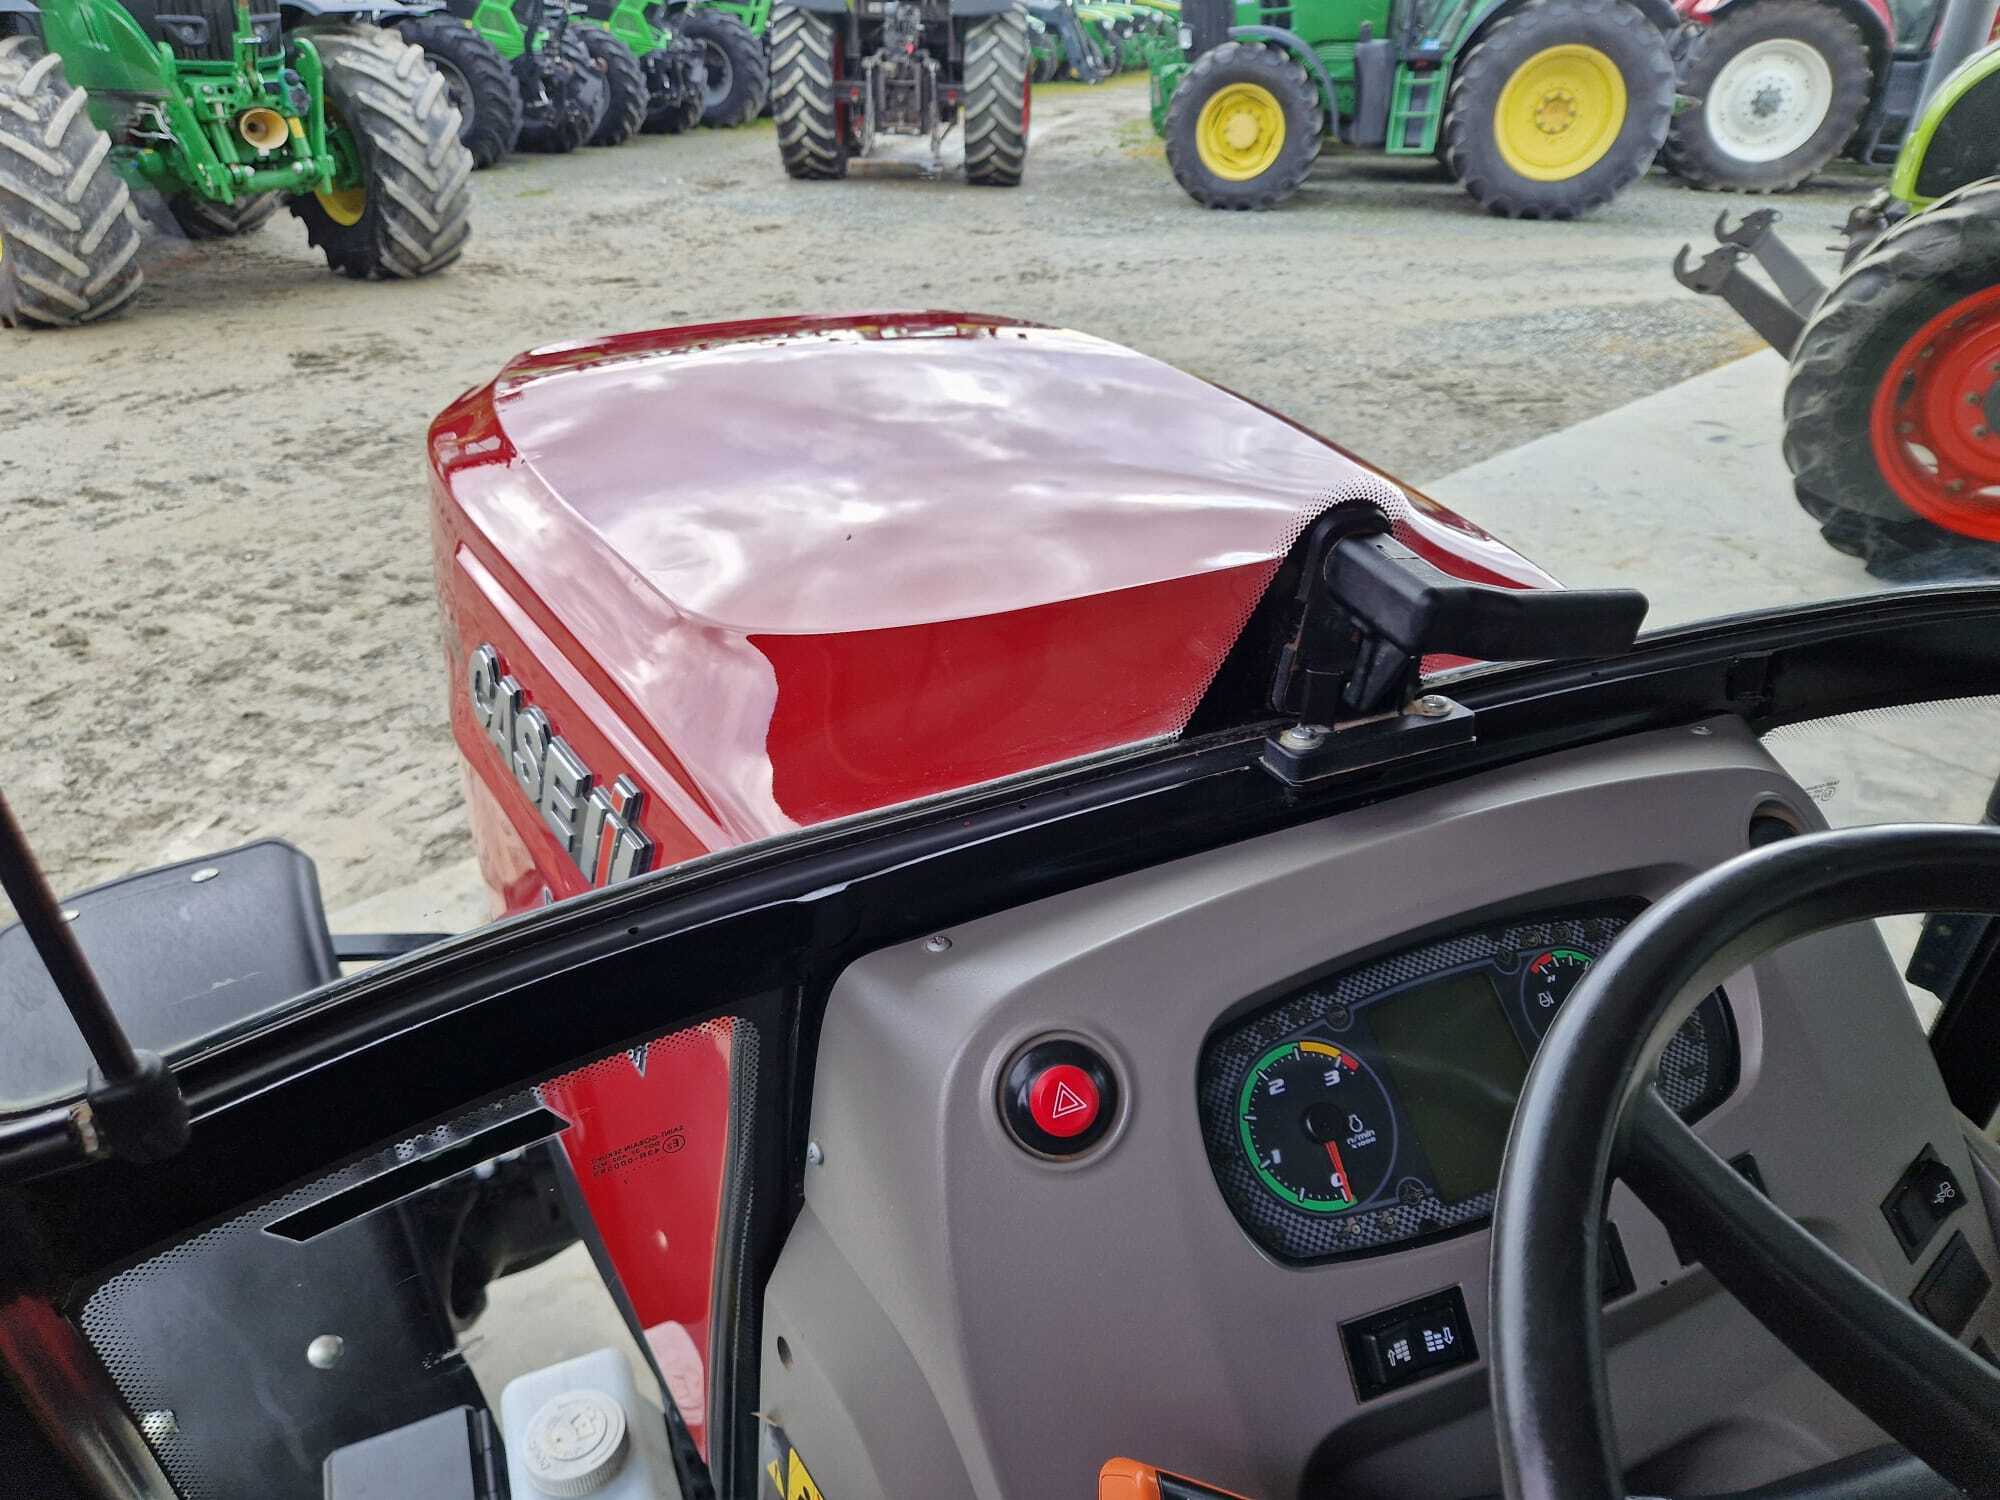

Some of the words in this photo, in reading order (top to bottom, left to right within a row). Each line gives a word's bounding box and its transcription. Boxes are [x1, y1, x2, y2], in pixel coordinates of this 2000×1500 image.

[469, 642, 593, 870] CASE
[1268, 1078, 1286, 1096] 2
[1323, 1069, 1341, 1087] 3
[1347, 1129, 1376, 1145] n/min
[1271, 1149, 1282, 1165] 1
